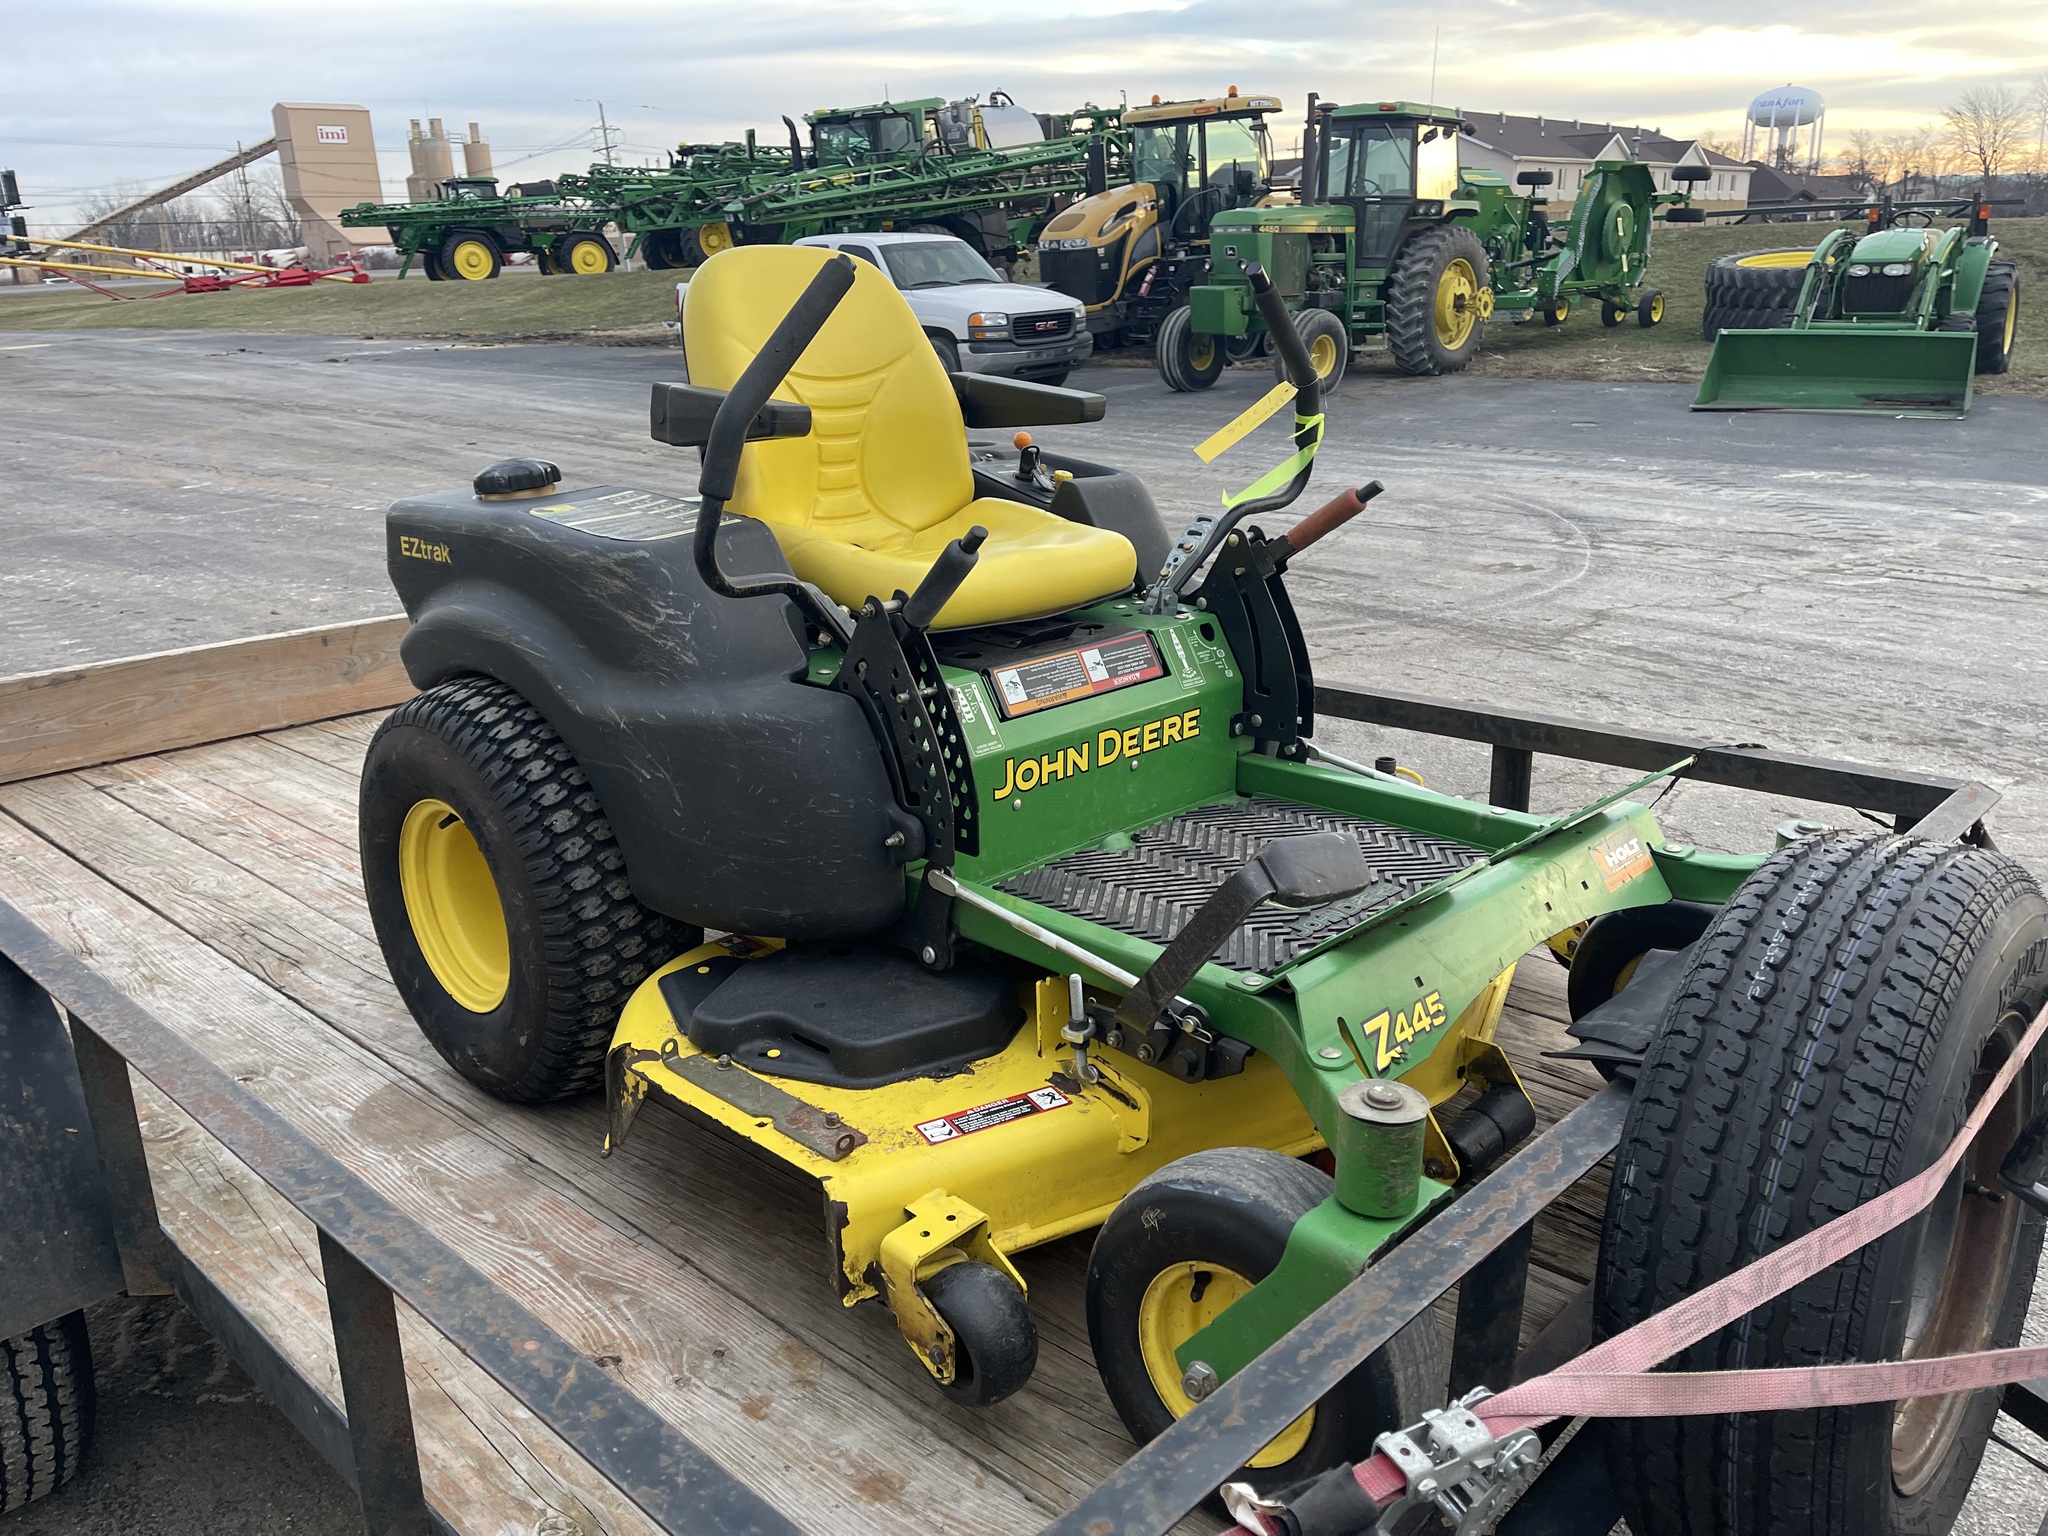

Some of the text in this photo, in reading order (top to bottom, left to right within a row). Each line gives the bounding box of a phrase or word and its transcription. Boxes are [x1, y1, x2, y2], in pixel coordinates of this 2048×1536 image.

[319, 128, 346, 140] imi
[1036, 320, 1058, 332] GMC
[400, 535, 452, 564] EZtrak
[1112, 673, 1134, 686] DANGER
[1036, 694, 1062, 706] WARNING
[993, 708, 1200, 800] JOHN DEERE
[1604, 838, 1640, 868] HOLT
[1362, 990, 1448, 1073] Z445
[973, 1098, 1010, 1112] DANGER
